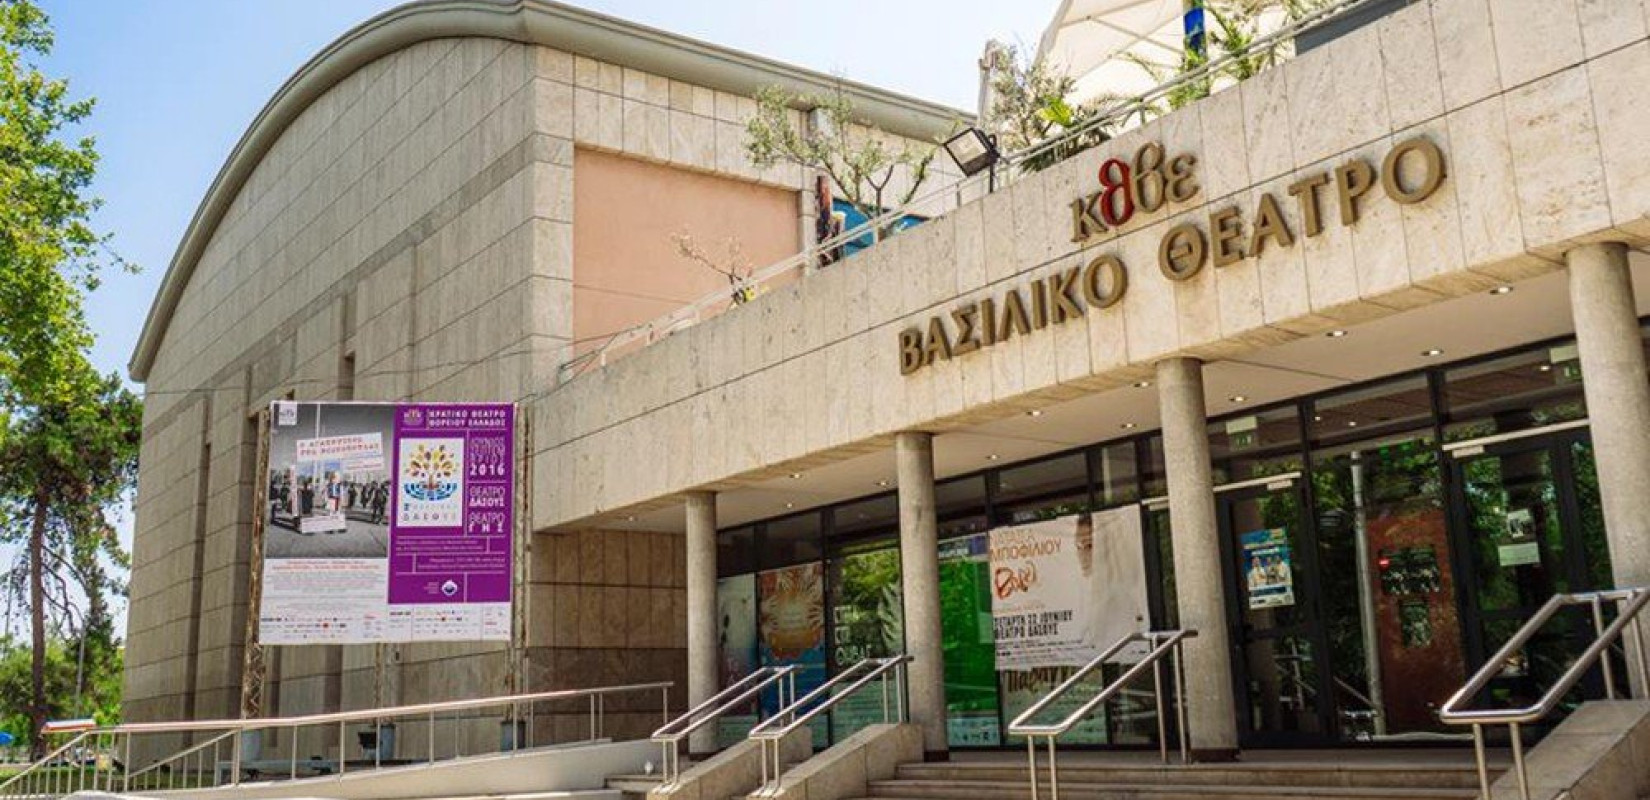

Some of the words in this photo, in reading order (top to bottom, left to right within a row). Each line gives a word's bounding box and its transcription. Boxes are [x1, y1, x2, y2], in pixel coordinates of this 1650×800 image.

[898, 253, 1129, 376] ΒΑΣΙΛΙΚΟ
[1158, 137, 1448, 282] ΘΕΑΤΡΟ
[471, 410, 505, 418] ΘΕΑΤΡΟ
[470, 463, 506, 476] 2016
[470, 486, 506, 498] ΘΕΑΤΡΟ
[469, 497, 505, 507] ΔΑΣΟΥΣ
[470, 512, 506, 524] ΘΕΑΤΡΟ
